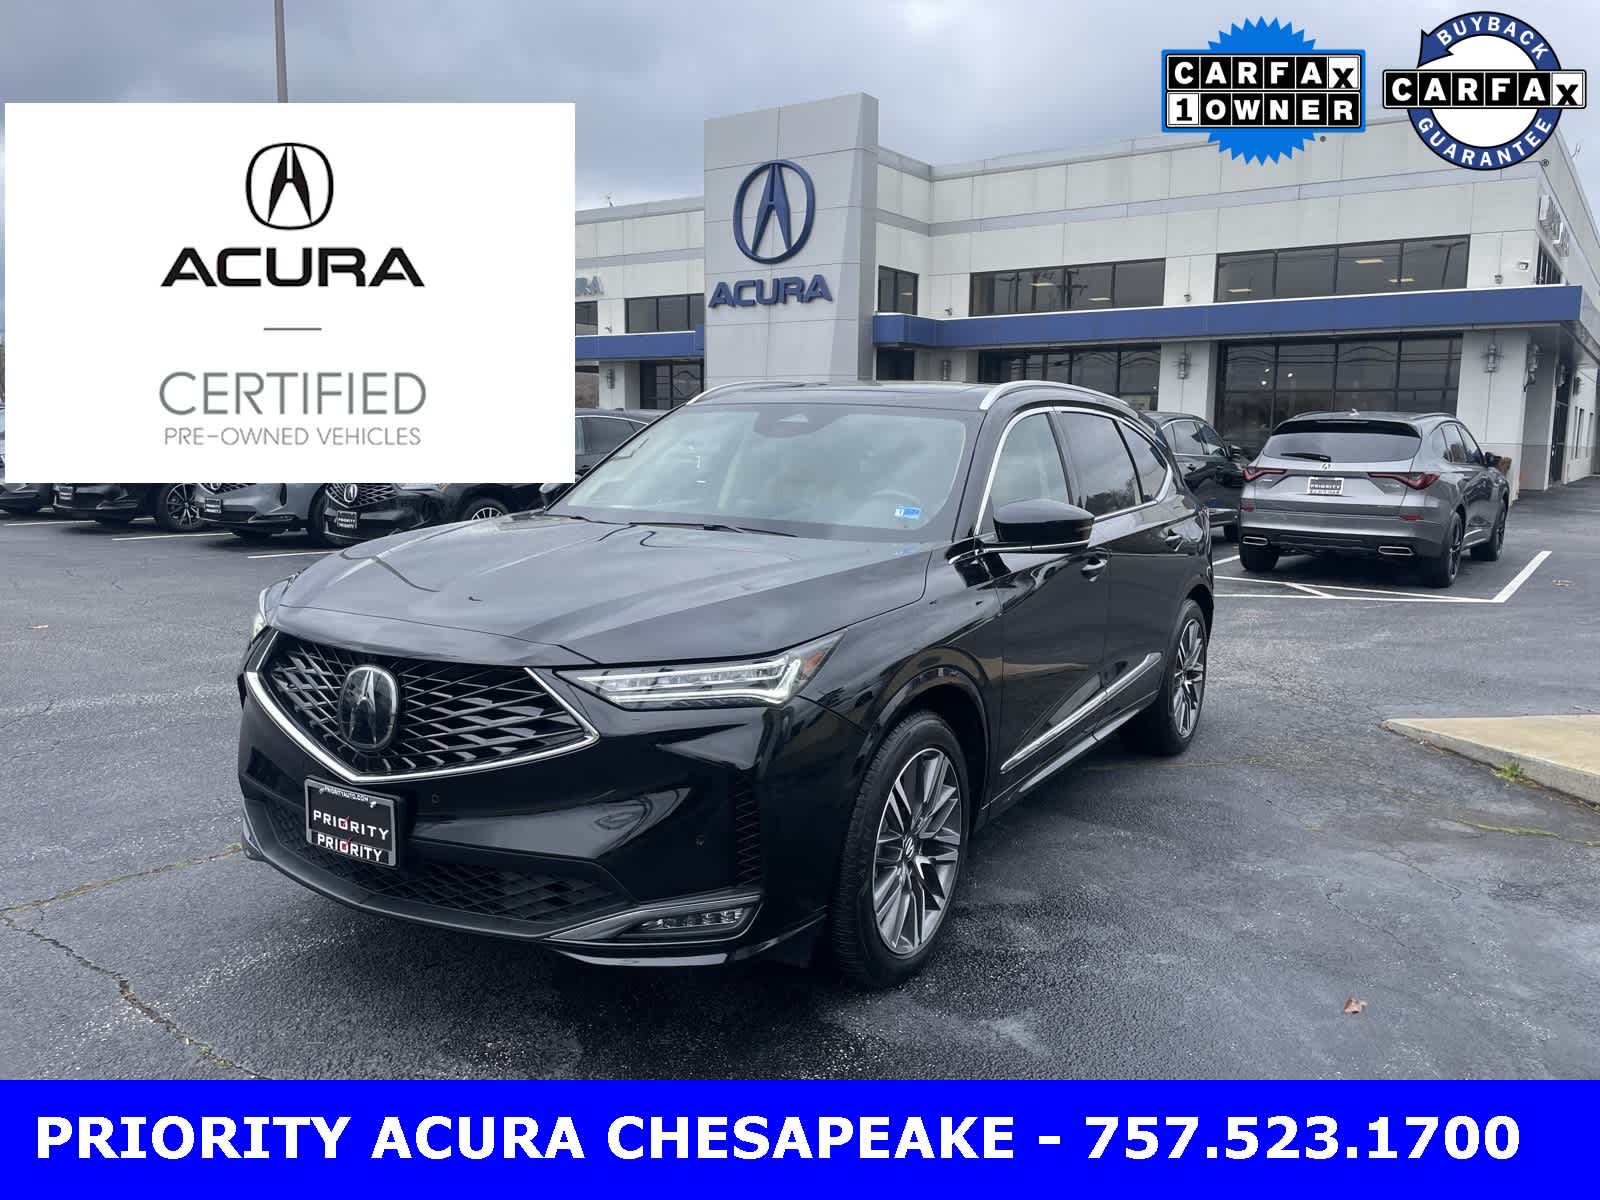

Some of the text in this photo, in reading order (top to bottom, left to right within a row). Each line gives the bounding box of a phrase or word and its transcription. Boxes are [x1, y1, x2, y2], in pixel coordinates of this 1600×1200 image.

[708, 274, 833, 309] ACURA
[313, 809, 389, 840] PRIORITY
[317, 833, 382, 861] PRIORITY
